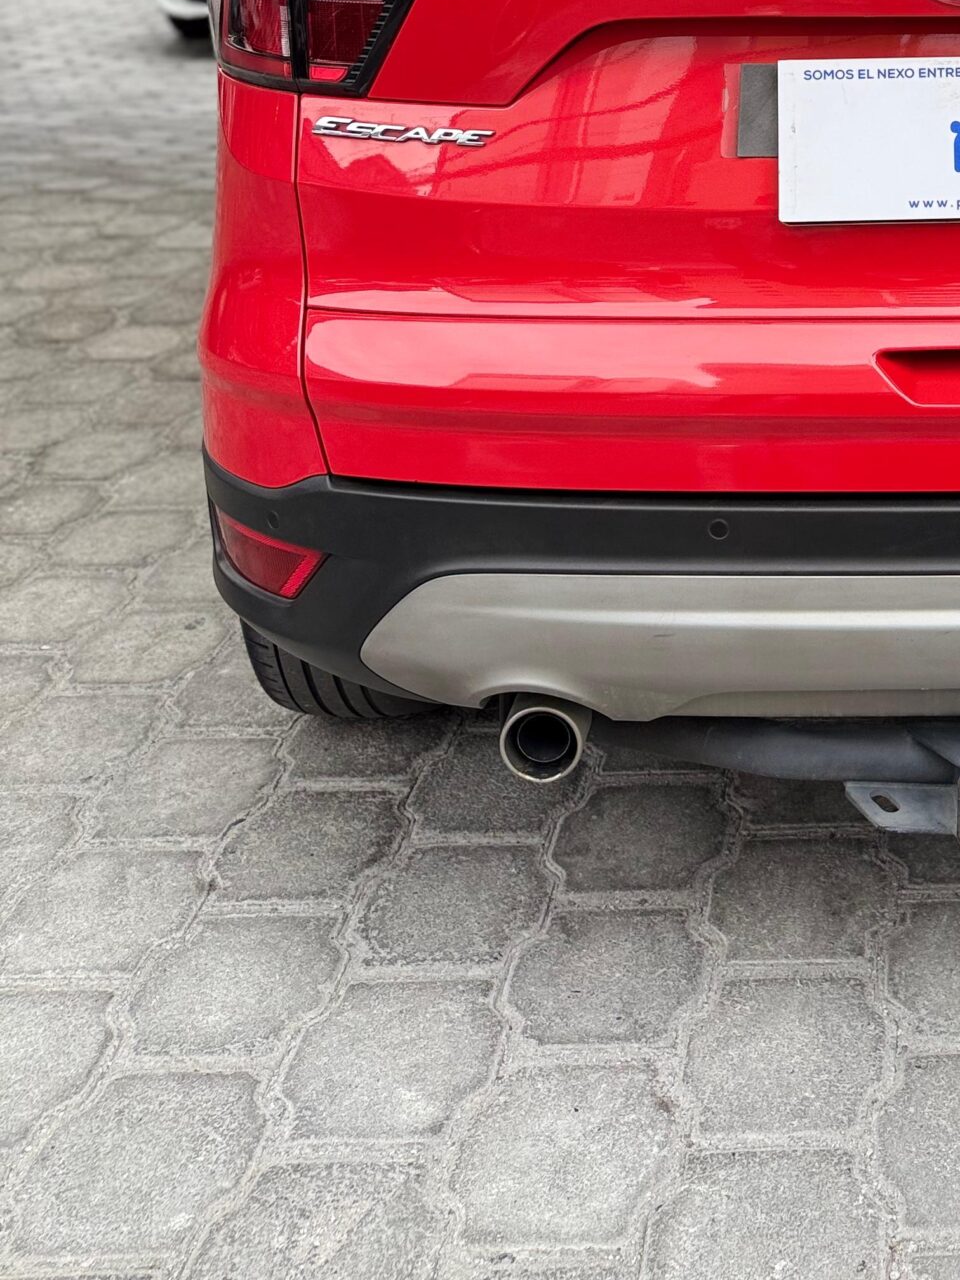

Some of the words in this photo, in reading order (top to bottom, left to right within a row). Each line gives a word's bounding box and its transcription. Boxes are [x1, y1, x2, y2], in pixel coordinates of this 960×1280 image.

[803, 69, 854, 81] SOMOS
[858, 69, 874, 79] EL
[877, 68, 915, 79] NEXO
[312, 116, 496, 147] ESCAPE
